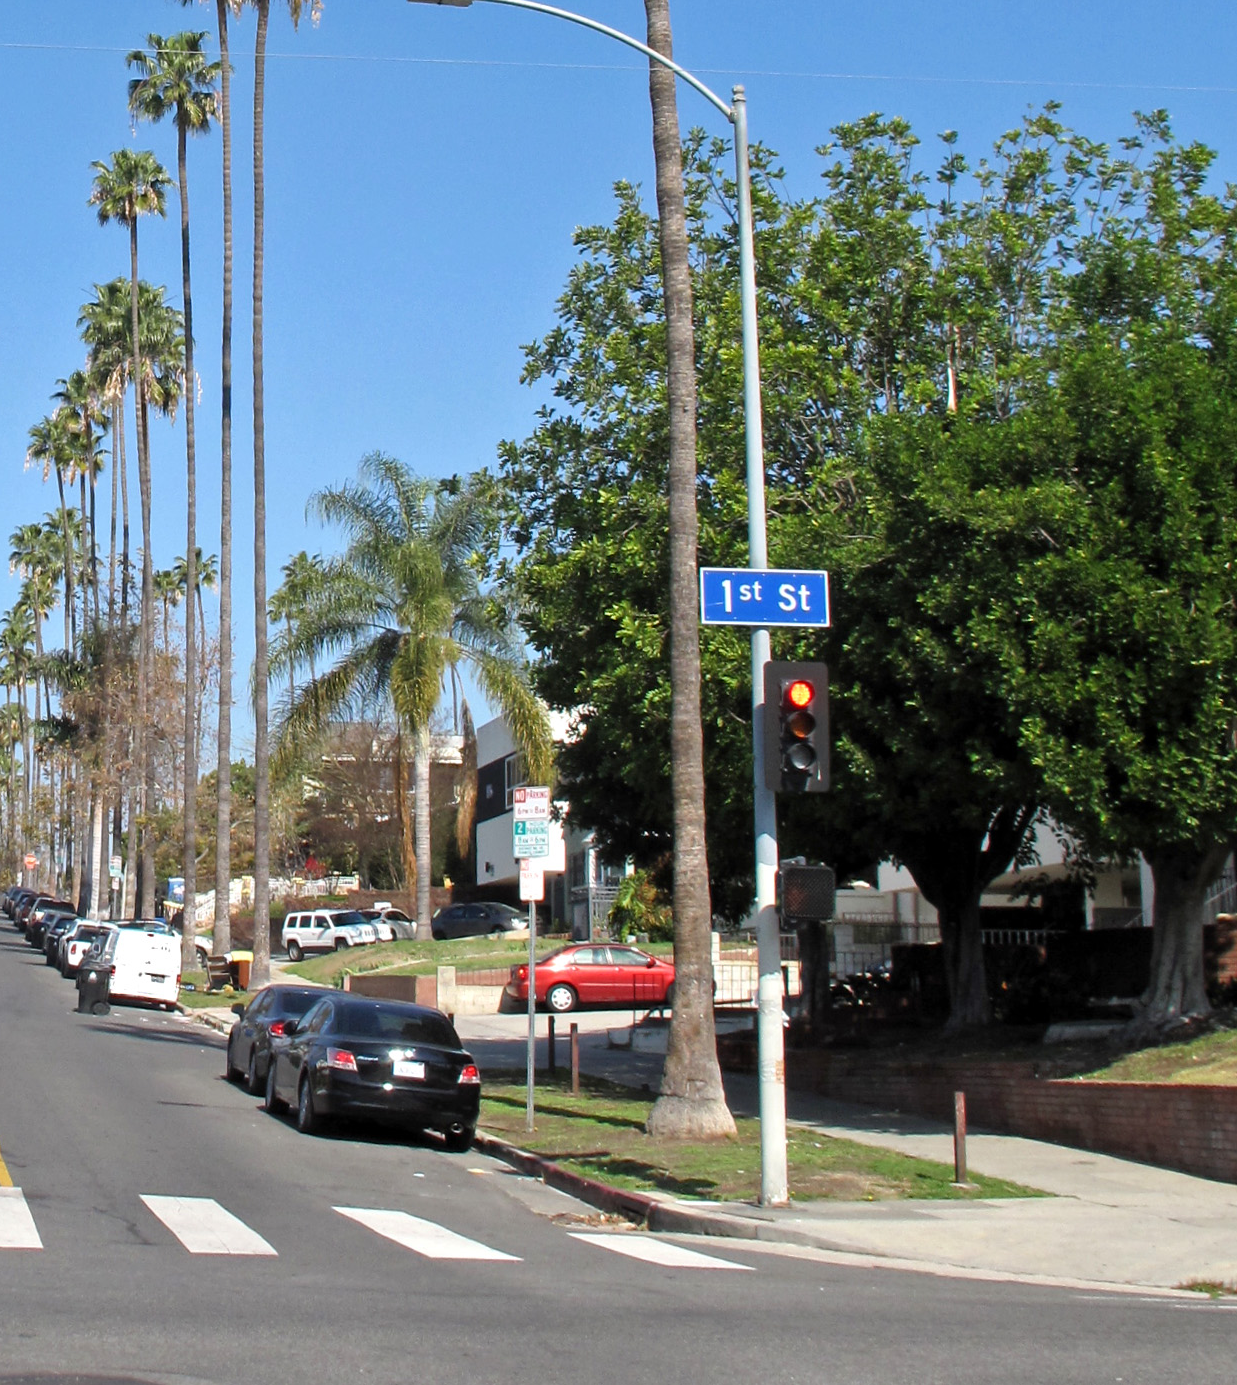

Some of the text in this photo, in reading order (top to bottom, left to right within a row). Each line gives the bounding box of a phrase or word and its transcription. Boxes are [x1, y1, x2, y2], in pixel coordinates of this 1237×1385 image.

[721, 579, 811, 613] 1st St
[515, 789, 548, 801] NO PARKING
[517, 822, 523, 834] 2
[526, 827, 548, 835] PARKING
